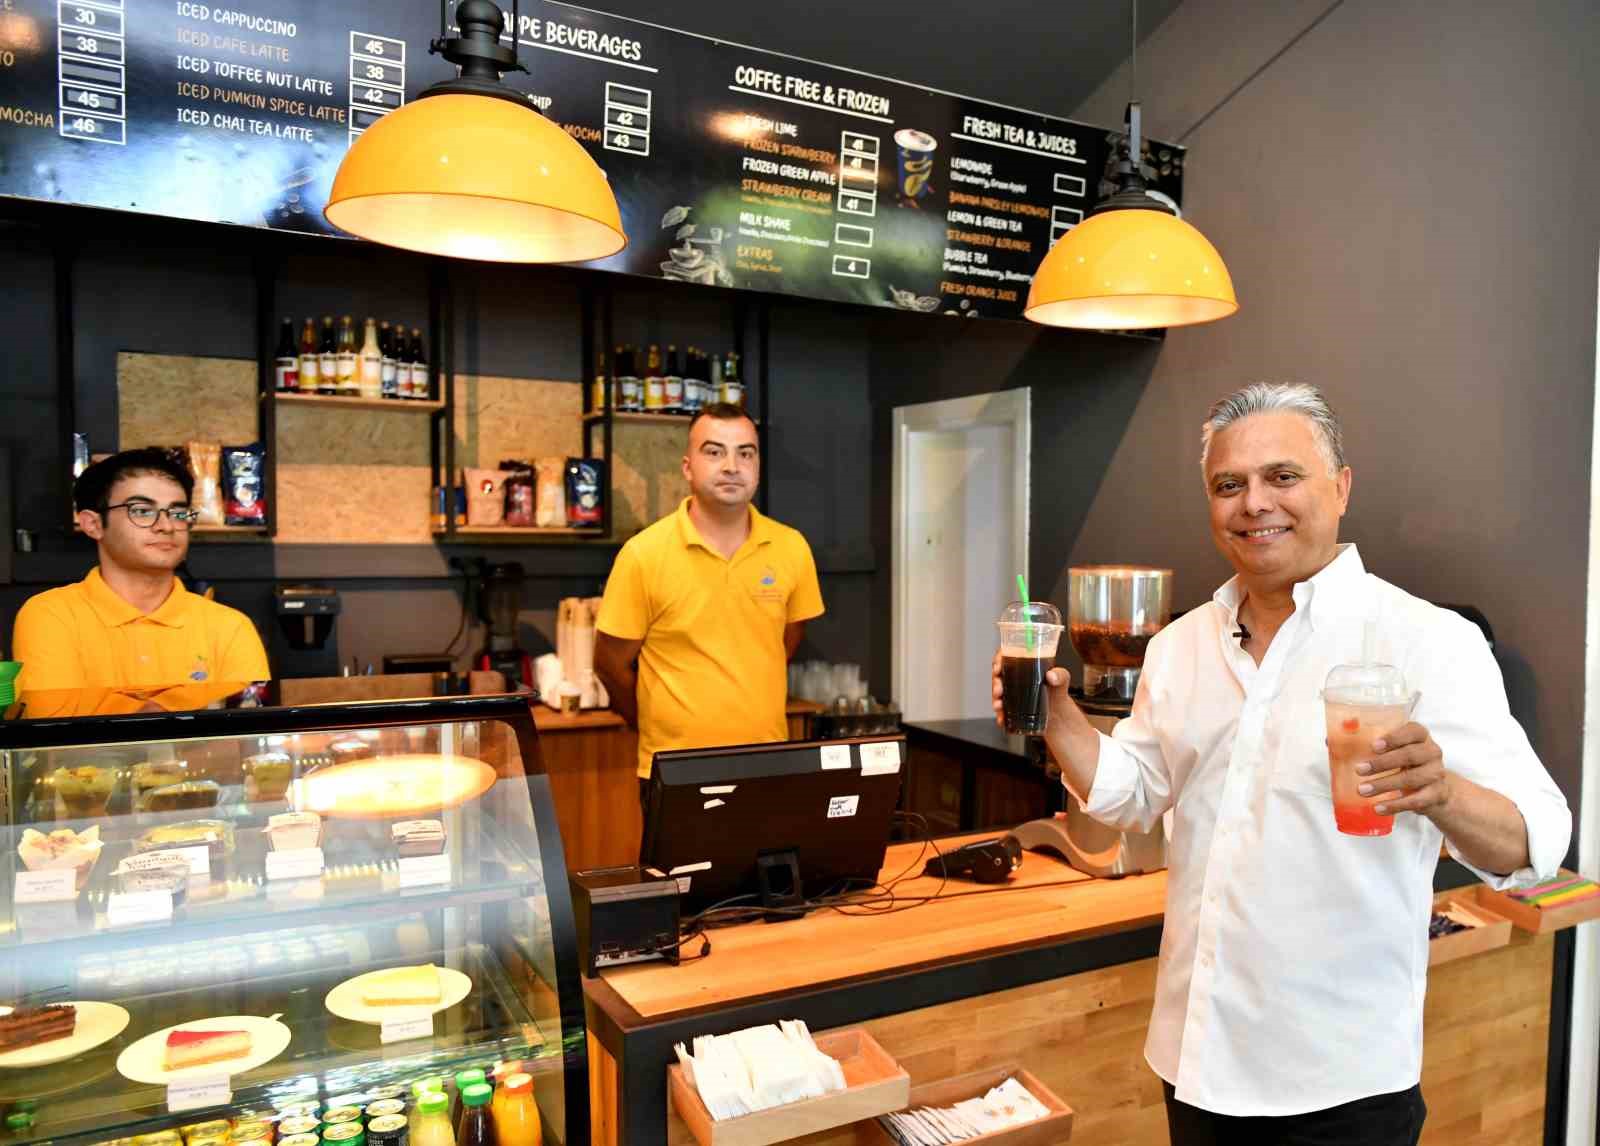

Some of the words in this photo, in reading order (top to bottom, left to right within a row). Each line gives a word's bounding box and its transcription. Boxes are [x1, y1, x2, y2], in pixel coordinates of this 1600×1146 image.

[75, 8, 96, 26] 30
[176, 2, 209, 19] ICED
[213, 9, 297, 38] CAPPUCCINO
[76, 36, 98, 54] 38
[176, 29, 209, 47] ICED
[213, 36, 249, 54] CAFE
[252, 43, 289, 62] LATTE
[364, 40, 384, 55] 45
[546, 21, 642, 61] BEVERAGES
[176, 55, 209, 73] ICED
[214, 60, 263, 83] TOFFEE
[266, 71, 293, 88] NUT
[295, 76, 333, 96] LATTE
[365, 65, 384, 80] 38
[78, 90, 100, 108] 45
[364, 89, 384, 103] 42
[735, 65, 782, 93] COFFE
[785, 76, 821, 100] FREE
[823, 86, 837, 105] &
[837, 88, 890, 116] FROZEN
[176, 82, 209, 100] ICED
[213, 88, 266, 109] PUMKIN
[269, 98, 306, 117] SPICE
[309, 104, 346, 123] LATTE
[0, 106, 54, 128] MOCHA
[73, 119, 96, 134] 46
[176, 108, 210, 126] ICED
[213, 115, 246, 132] CHAI
[248, 120, 272, 136] TEA
[275, 124, 313, 142] LATTE
[616, 113, 633, 126] 42
[775, 121, 798, 137] LIME
[963, 116, 1001, 139] FRESH
[1003, 124, 1024, 144] TEA
[1025, 130, 1036, 147] &
[1037, 132, 1077, 155] JUICES
[613, 134, 630, 148] 43
[742, 157, 779, 175] FROZEN
[780, 164, 810, 181] GREEN
[810, 170, 836, 186] APPLE
[951, 157, 992, 175] LEMONADE
[741, 179, 801, 198] STRAWBERRY
[801, 189, 832, 203] CREAM
[740, 211, 762, 226] MILK
[763, 215, 791, 231] SHAKE
[947, 210, 975, 225] LEMON
[983, 216, 1008, 230] GREEN
[1008, 220, 1022, 232] TEA
[737, 245, 773, 261] EXTRAS
[974, 252, 988, 264] TEA
